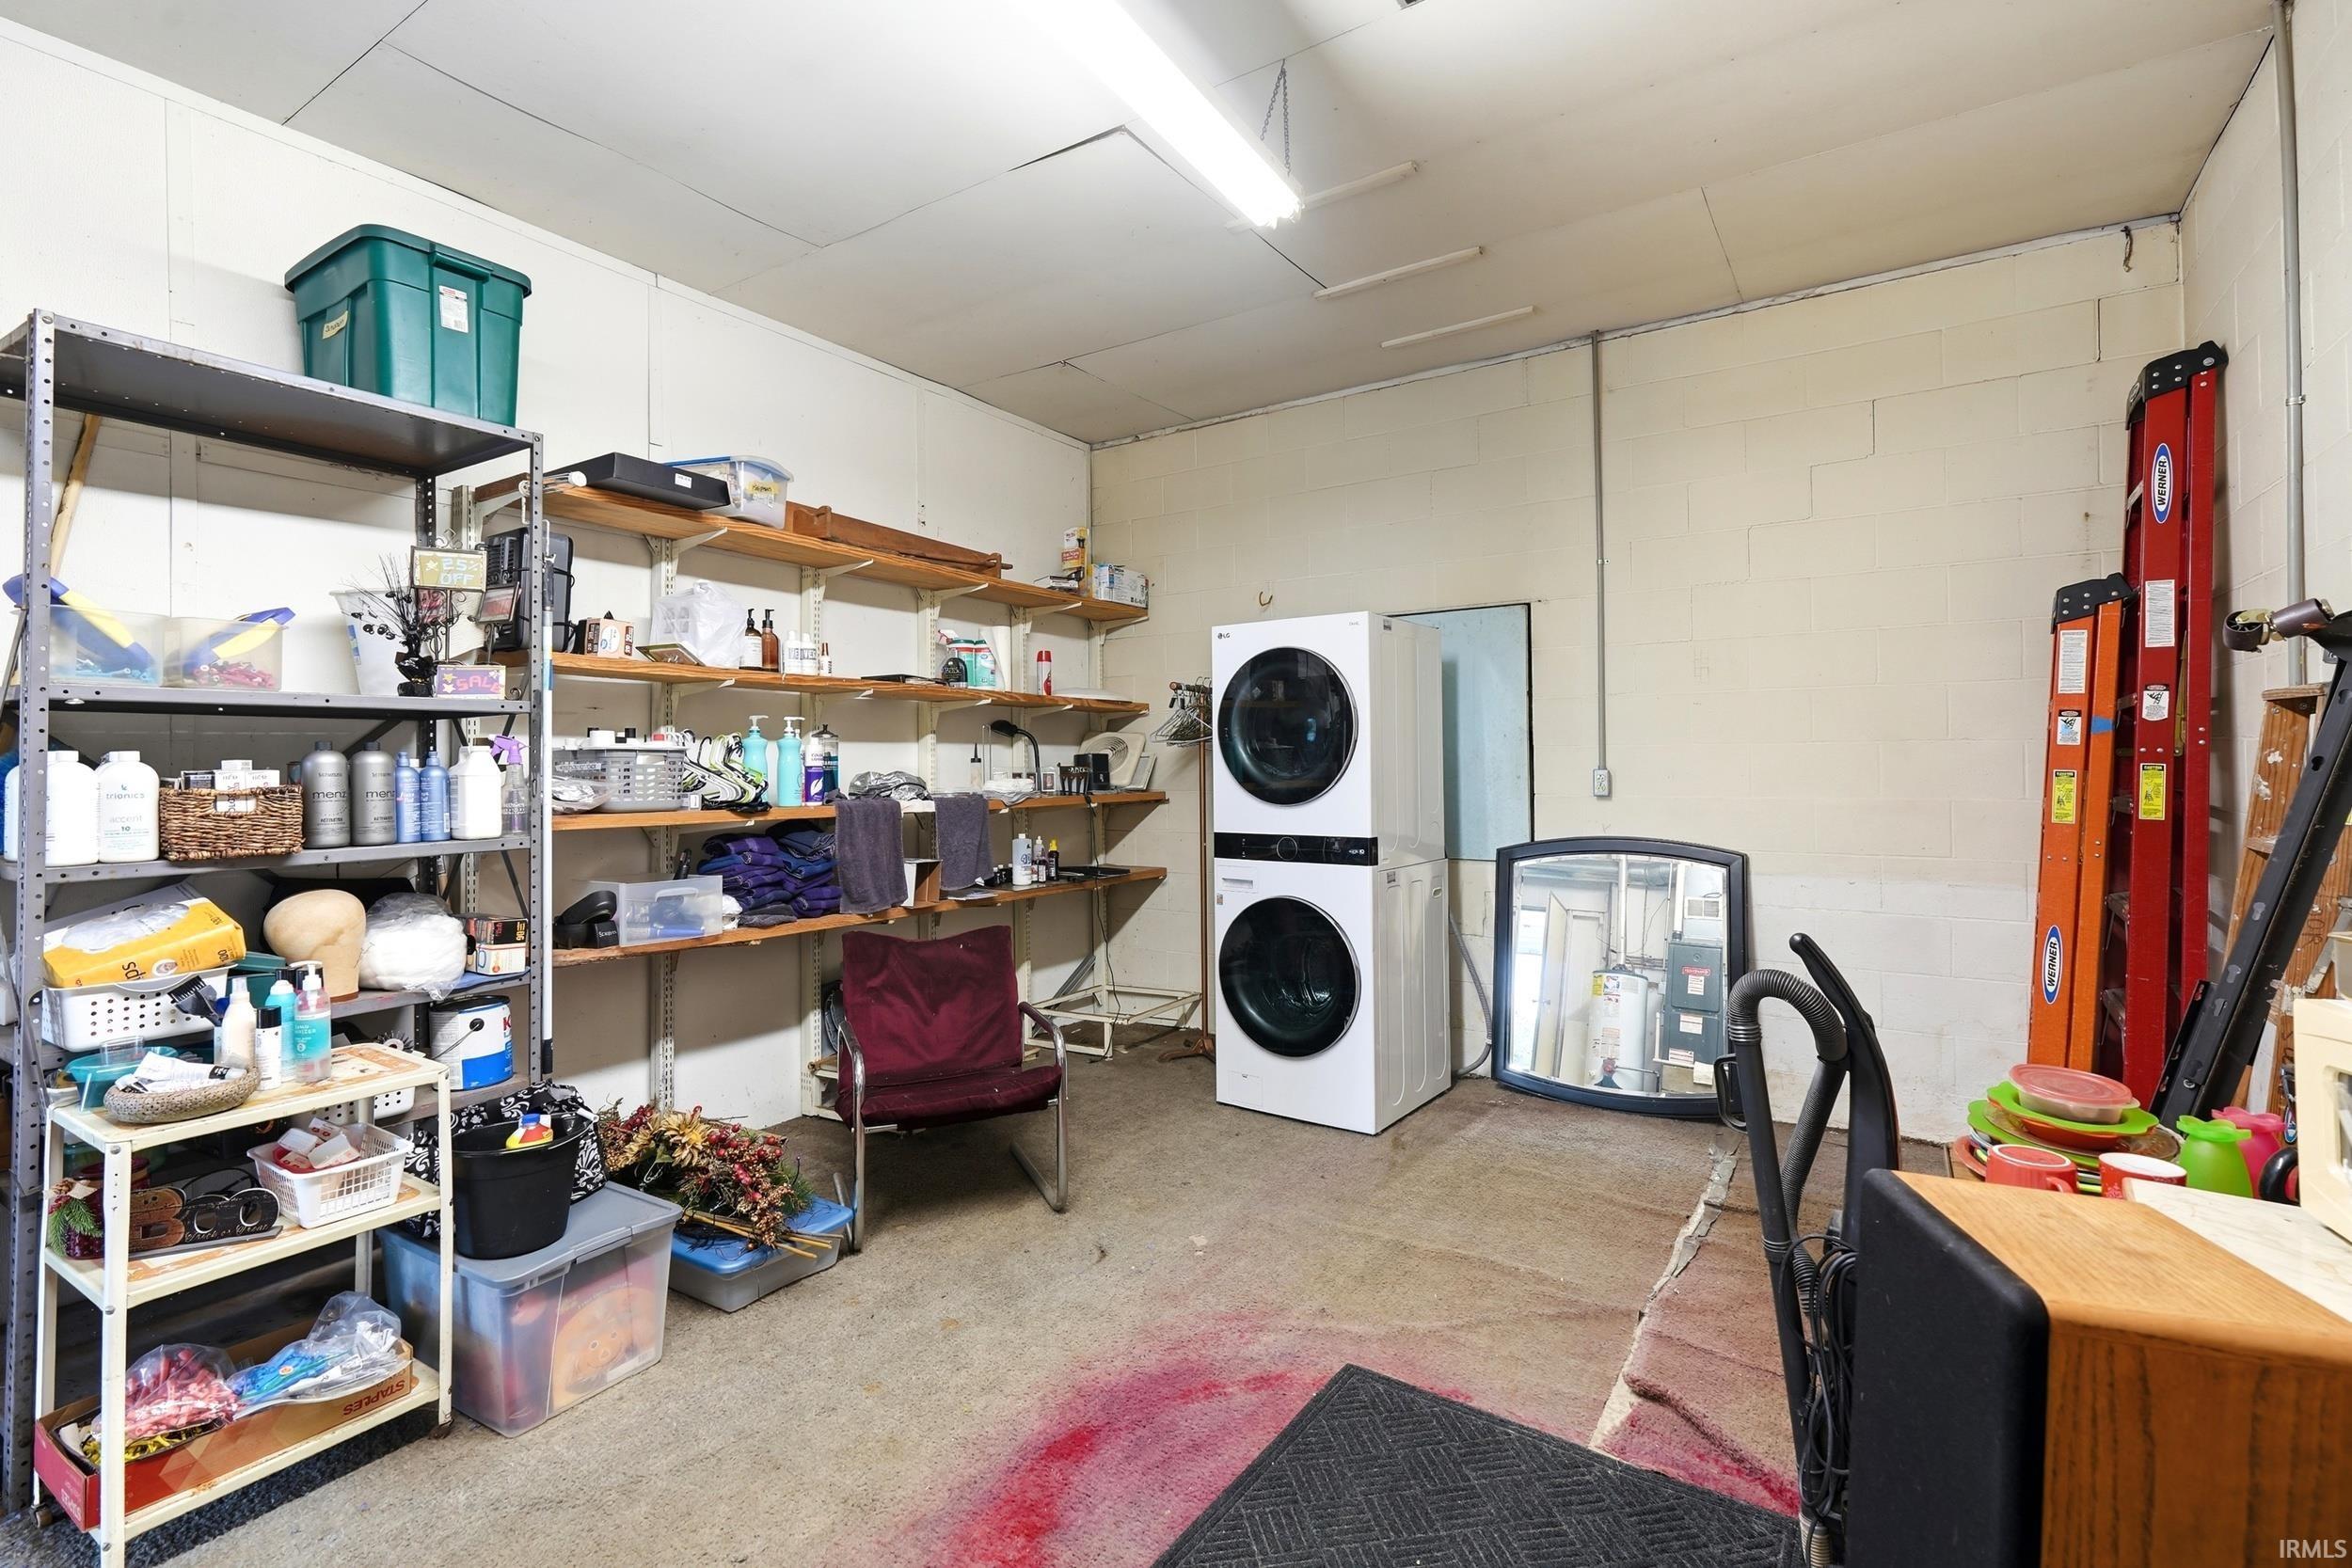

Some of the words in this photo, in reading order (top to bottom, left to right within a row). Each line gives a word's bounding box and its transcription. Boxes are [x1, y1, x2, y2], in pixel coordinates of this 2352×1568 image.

[2157, 459, 2168, 506] WERNER
[439, 573, 475, 585] OFF
[455, 674, 501, 693] SALE
[2047, 941, 2058, 987] WERNER
[342, 1380, 406, 1416] STAPLES
